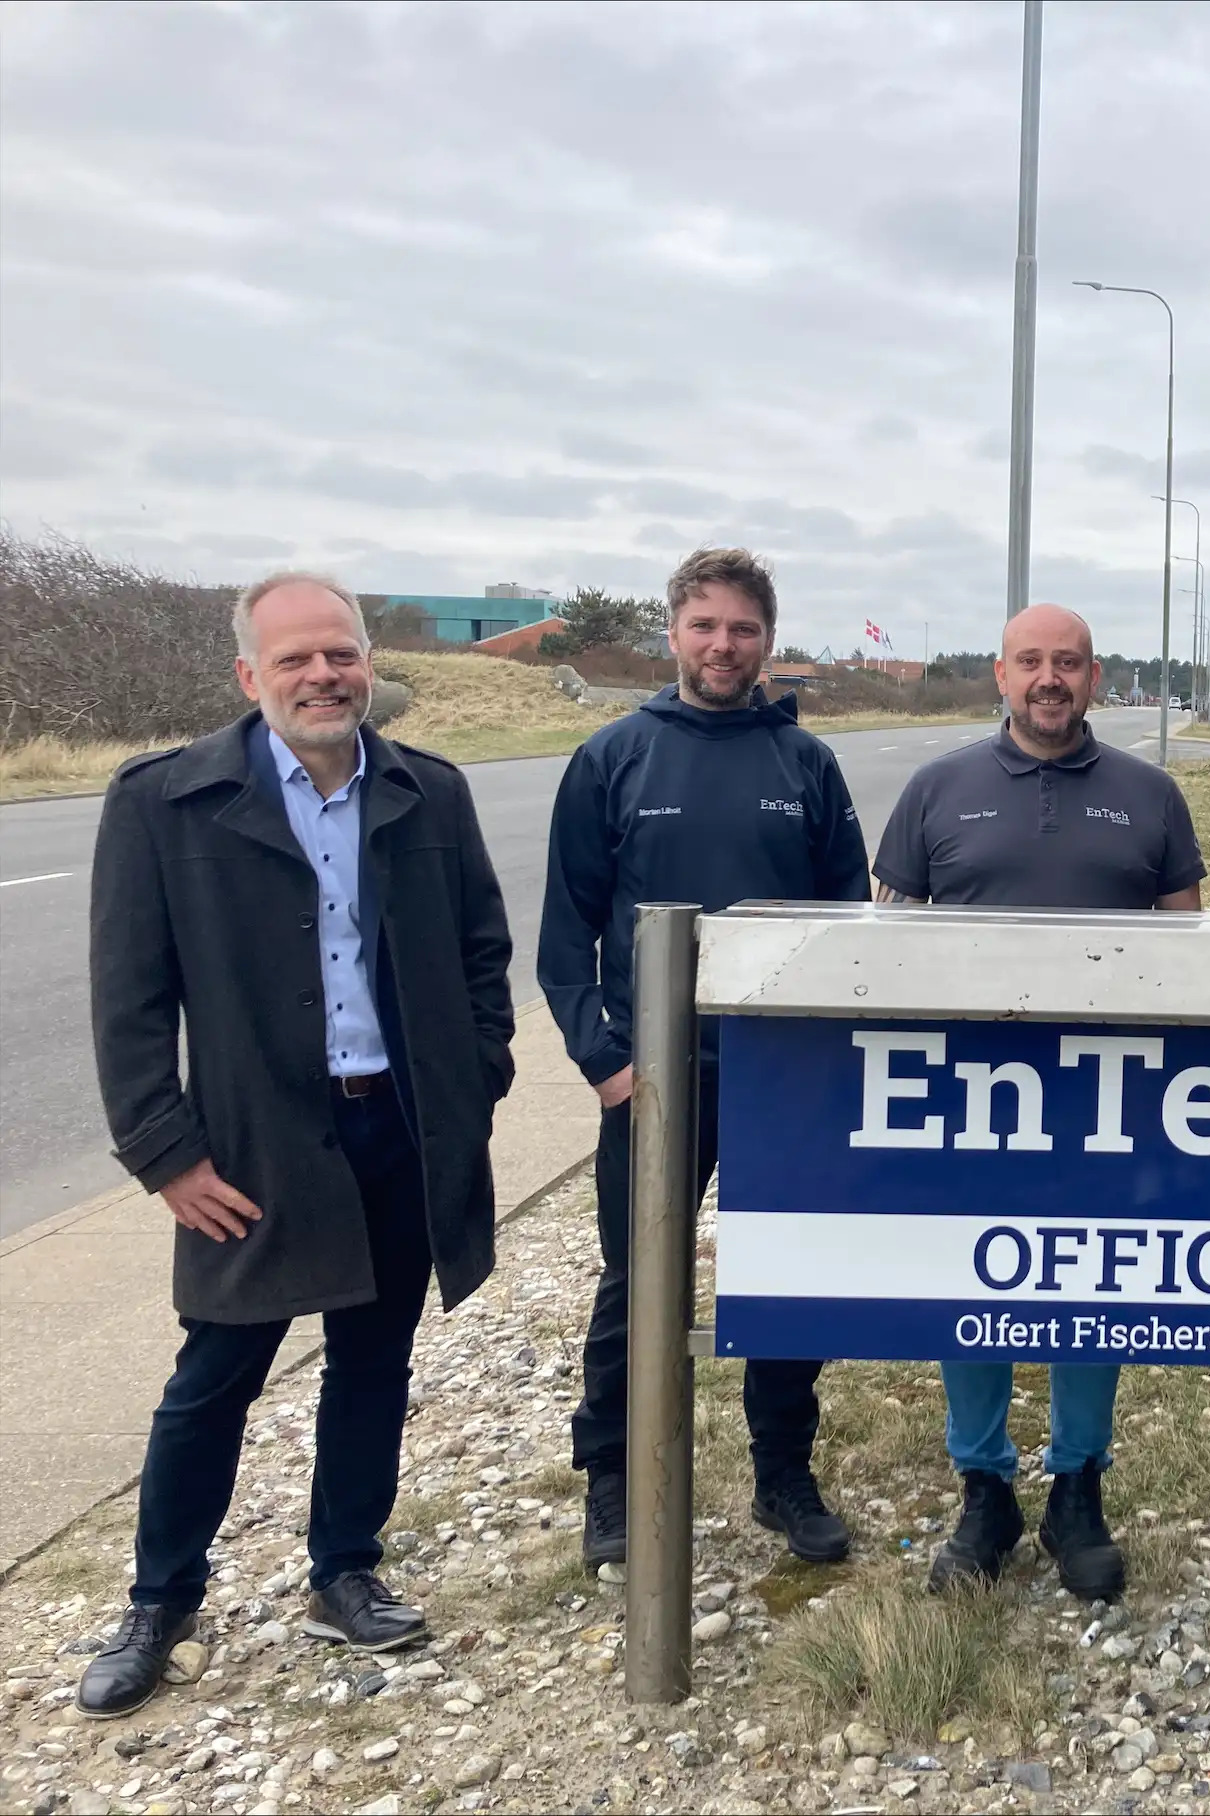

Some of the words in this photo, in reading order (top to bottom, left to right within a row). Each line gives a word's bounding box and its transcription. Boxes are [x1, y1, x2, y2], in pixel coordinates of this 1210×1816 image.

[760, 799, 804, 812] EnTech
[1086, 807, 1130, 821] EnTech
[955, 1312, 1061, 1348] Olfert
